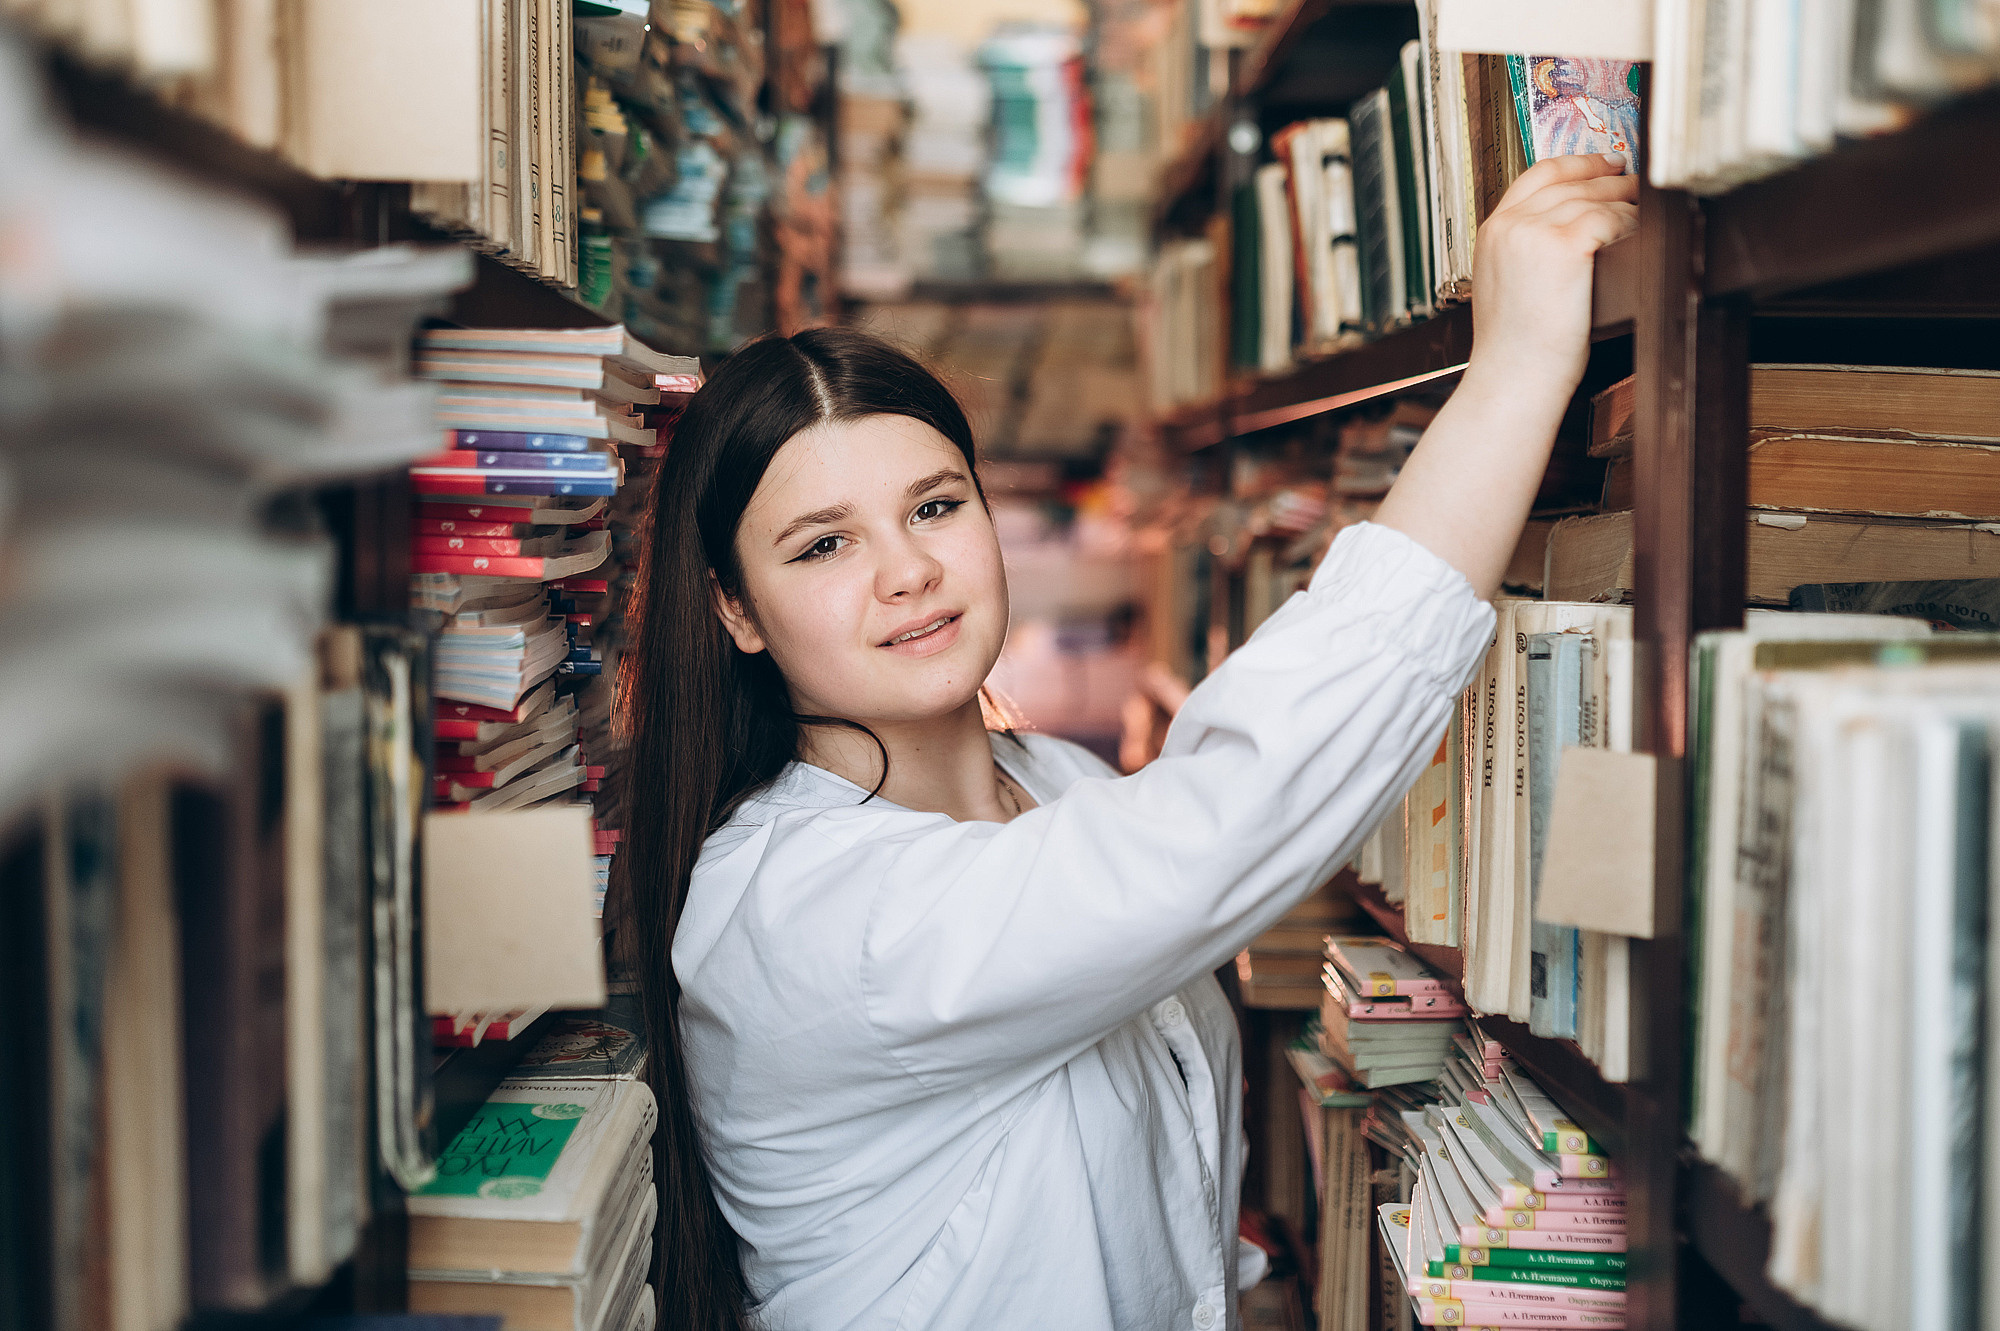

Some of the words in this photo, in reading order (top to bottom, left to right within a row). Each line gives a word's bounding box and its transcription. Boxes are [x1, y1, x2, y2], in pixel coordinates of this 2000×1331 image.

[1945, 603, 1990, 622] ГЮГО
[1486, 677, 1497, 751] ГОГОЛЬ
[1517, 685, 1526, 758] ГОГОЛЬ
